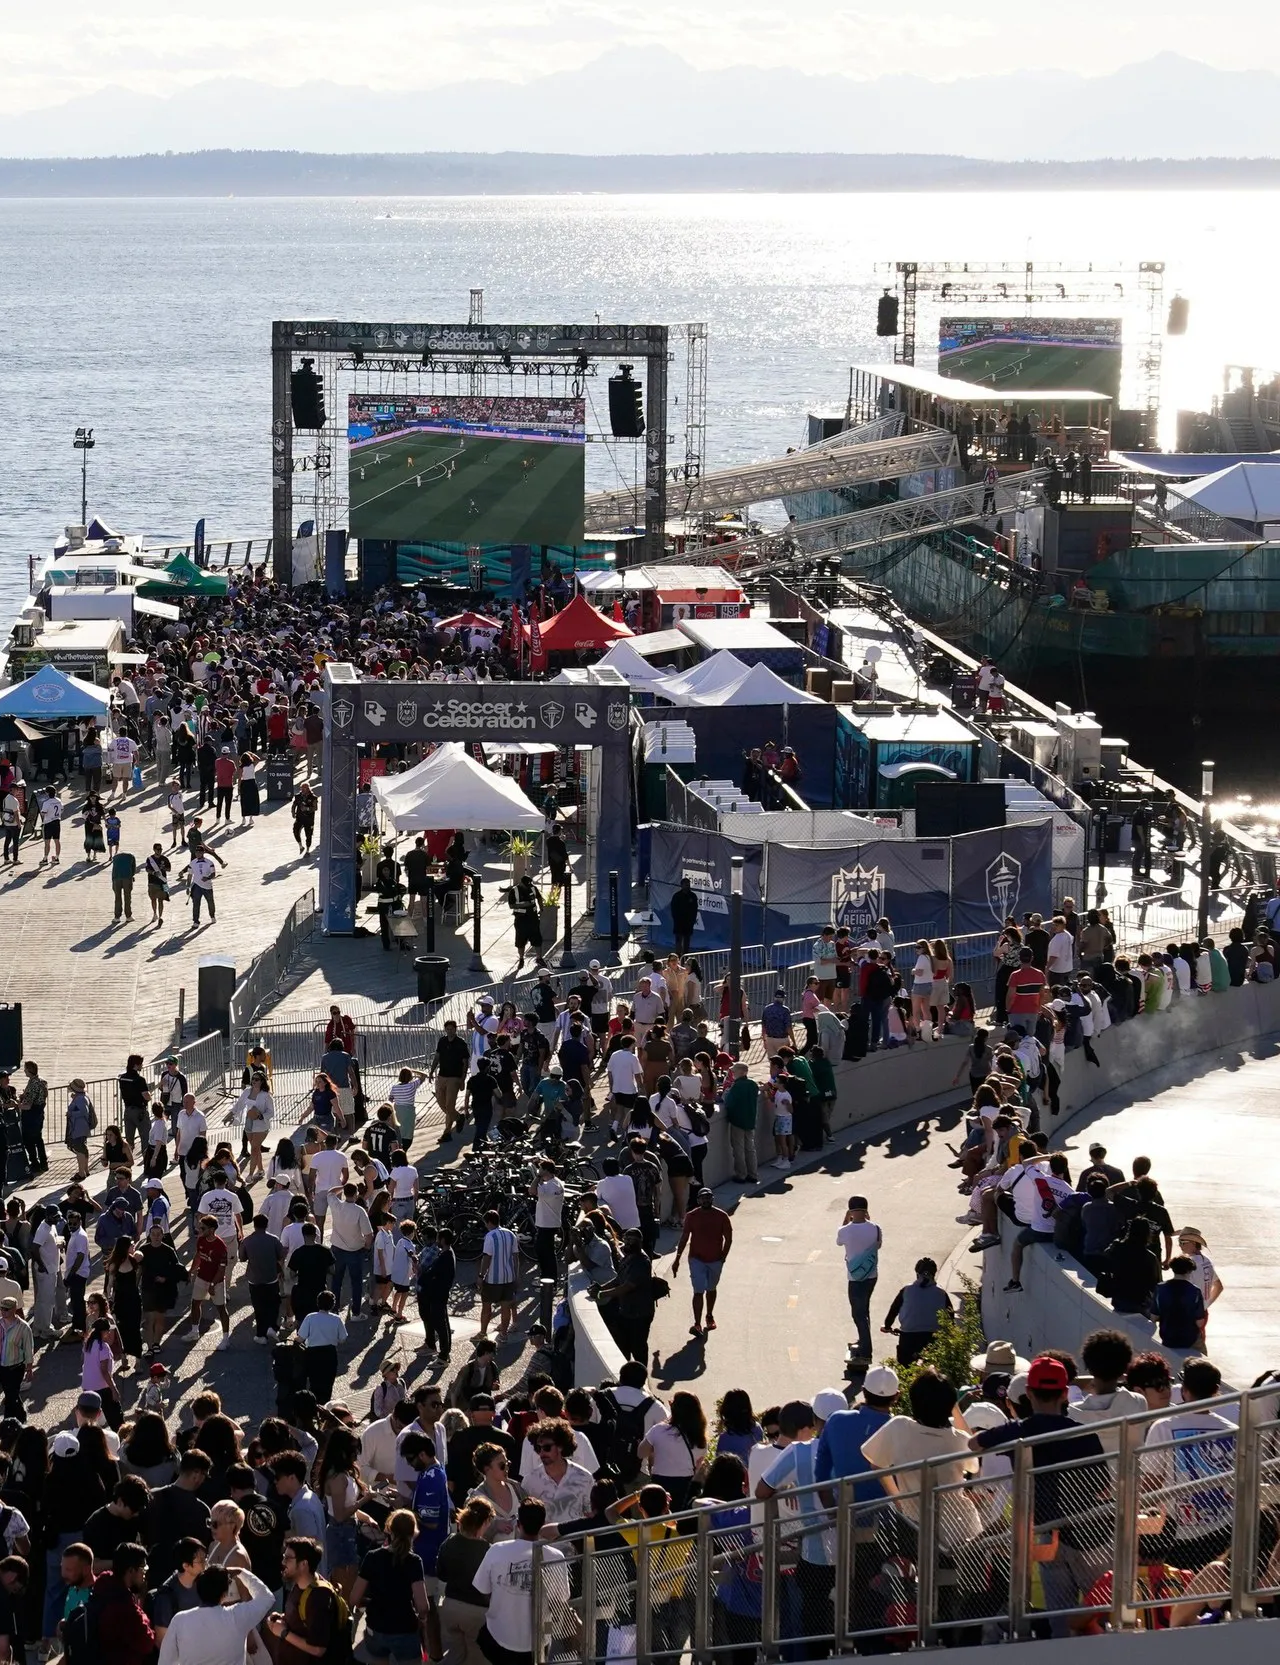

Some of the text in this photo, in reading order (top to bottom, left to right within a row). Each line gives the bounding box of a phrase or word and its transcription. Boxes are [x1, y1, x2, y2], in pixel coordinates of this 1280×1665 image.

[442, 330, 481, 341] Soccer
[428, 339, 495, 350] Celebration
[448, 699, 513, 715] Soccer
[424, 712, 536, 728] Celebration
[54, 805, 60, 816] 2
[714, 878, 723, 889] of
[844, 914, 872, 925] REIGN
[370, 1133, 383, 1152] 11
